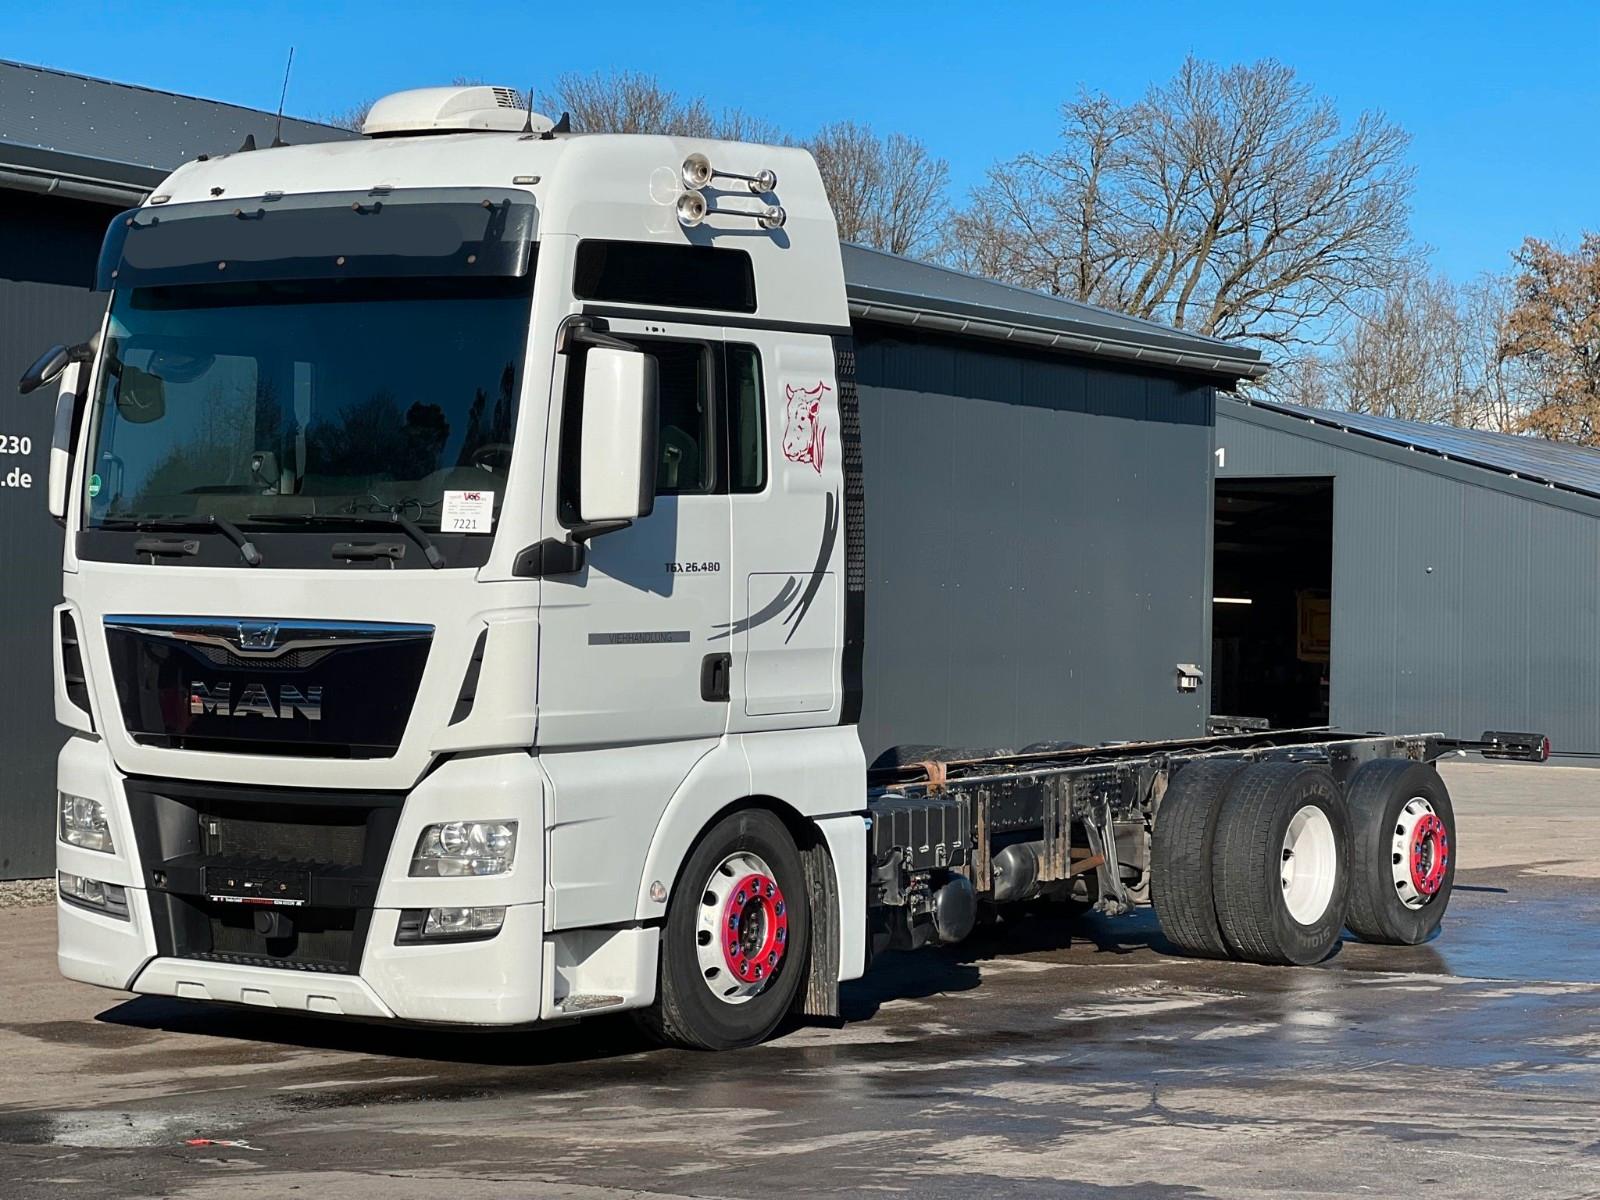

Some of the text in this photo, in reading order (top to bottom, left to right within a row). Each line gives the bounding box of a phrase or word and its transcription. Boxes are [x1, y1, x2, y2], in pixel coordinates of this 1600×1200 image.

[0, 435, 31, 455] 230
[1214, 447, 1225, 467] 1
[0, 467, 32, 488] .de
[453, 519, 477, 529] 7221
[685, 562, 720, 572] 26.480
[190, 680, 323, 721] MAN
